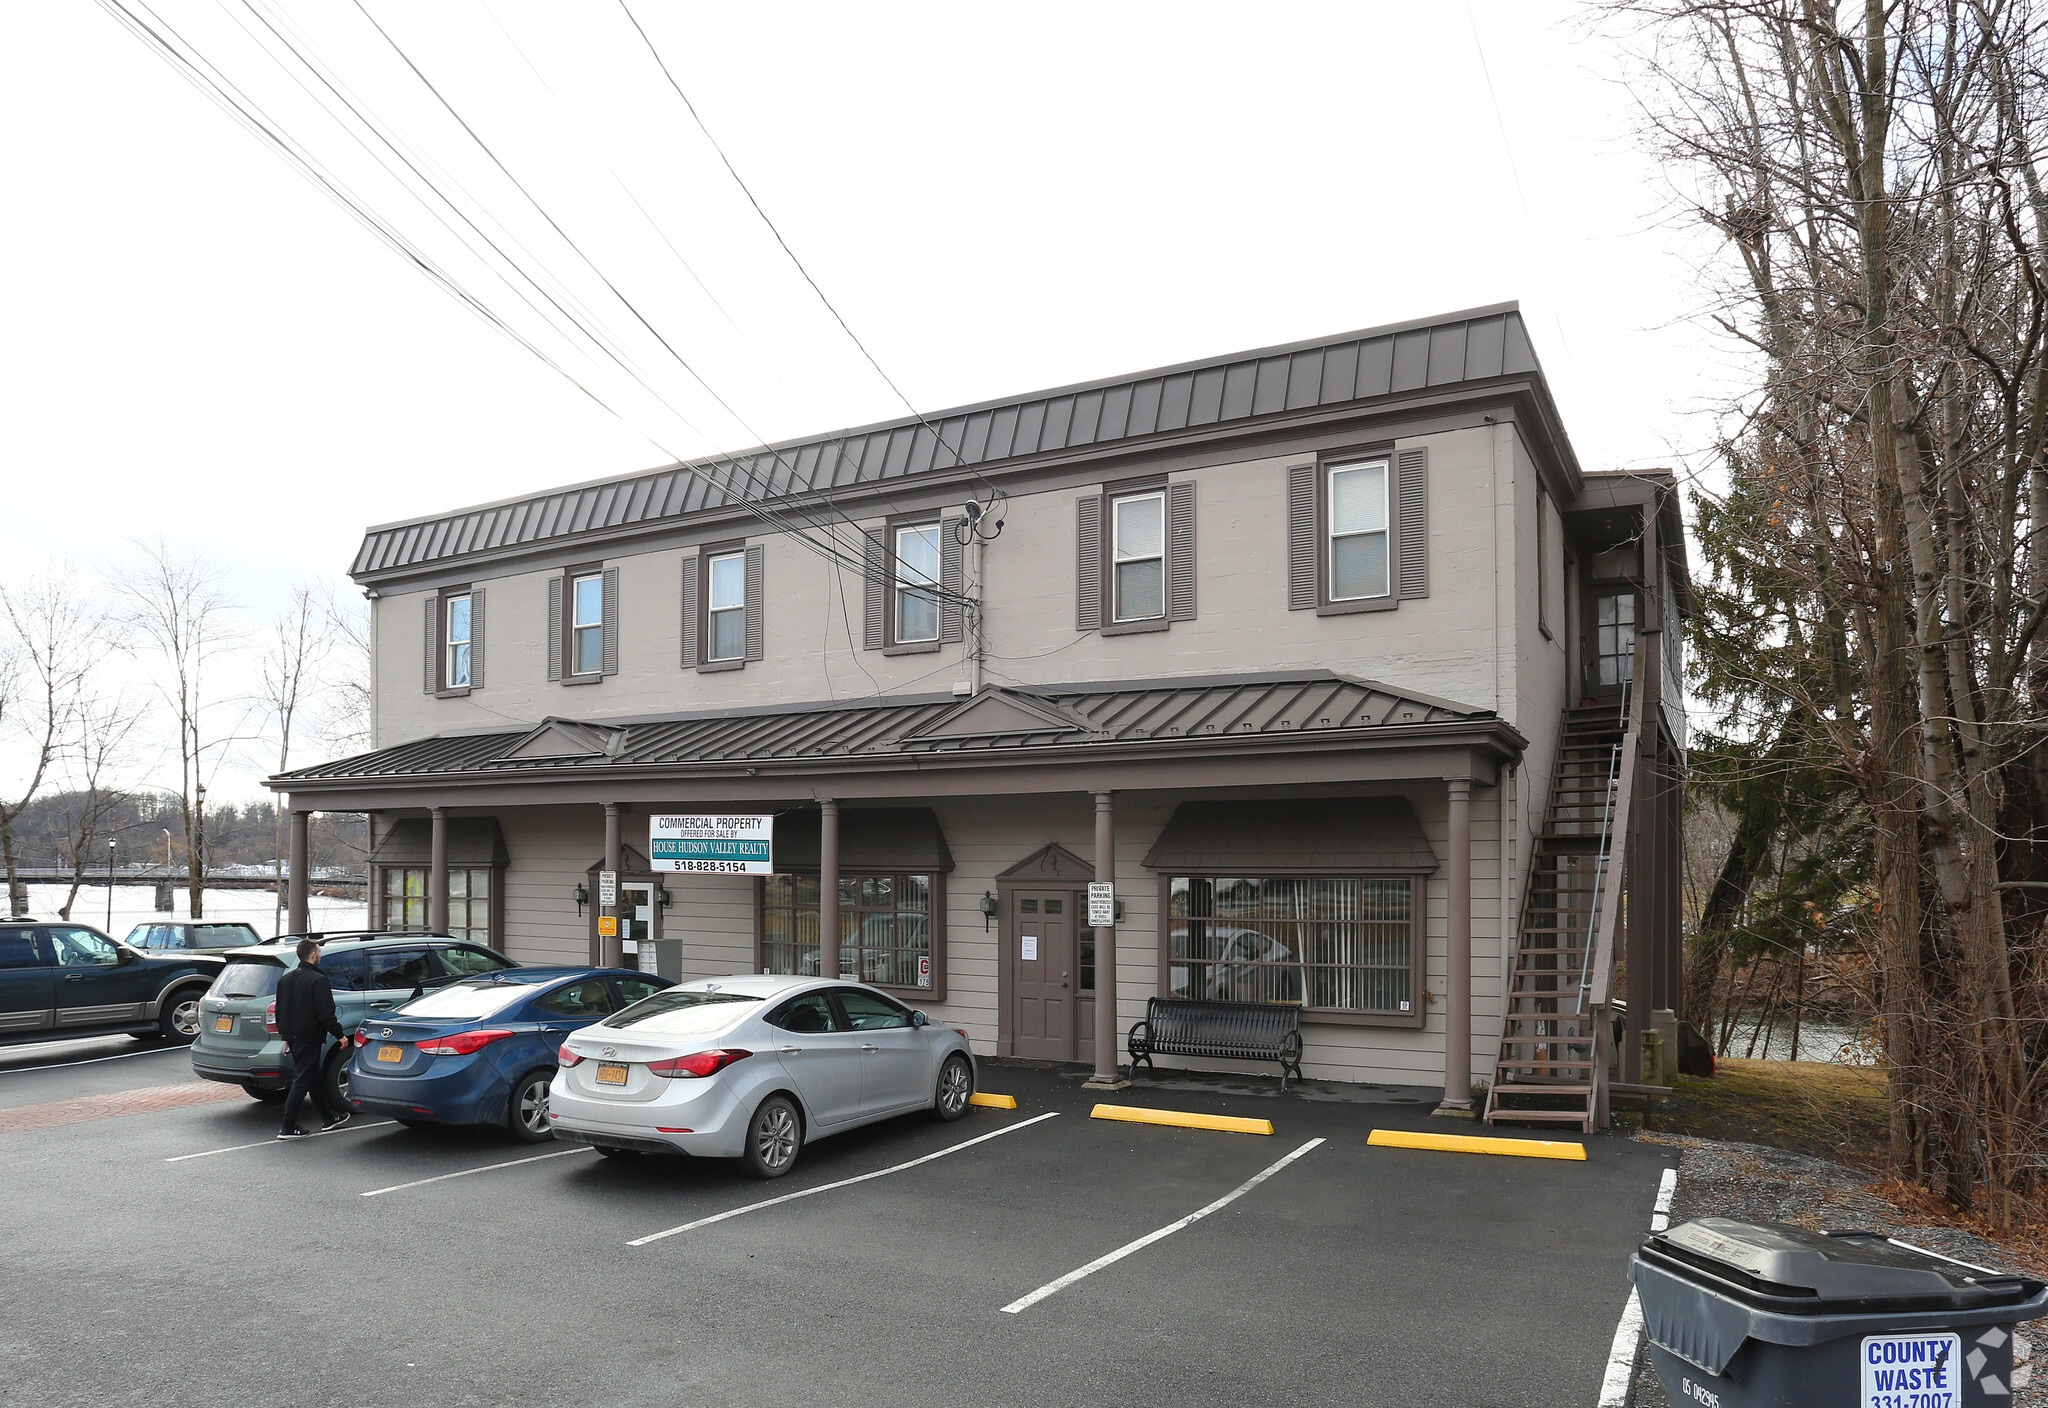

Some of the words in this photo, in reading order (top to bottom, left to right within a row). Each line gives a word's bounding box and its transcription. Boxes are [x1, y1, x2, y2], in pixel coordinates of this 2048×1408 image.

[659, 817, 714, 829] COMMERCIAL
[716, 817, 763, 830] PROPERTY
[680, 829, 704, 839] OFFERED
[704, 830, 715, 839] FOR
[716, 830, 729, 839] SALE
[730, 831, 738, 839] BY
[652, 841, 677, 854] HOUSE
[678, 841, 708, 854] HUDSON
[709, 842, 738, 855] VALLEY
[739, 842, 769, 856] REALTY
[674, 860, 747, 873] 518-828-5154
[1868, 1340, 1953, 1365] COUNTY
[1874, 1367, 1948, 1392] WASTE
[1870, 1392, 1953, 1408] 331-7007
